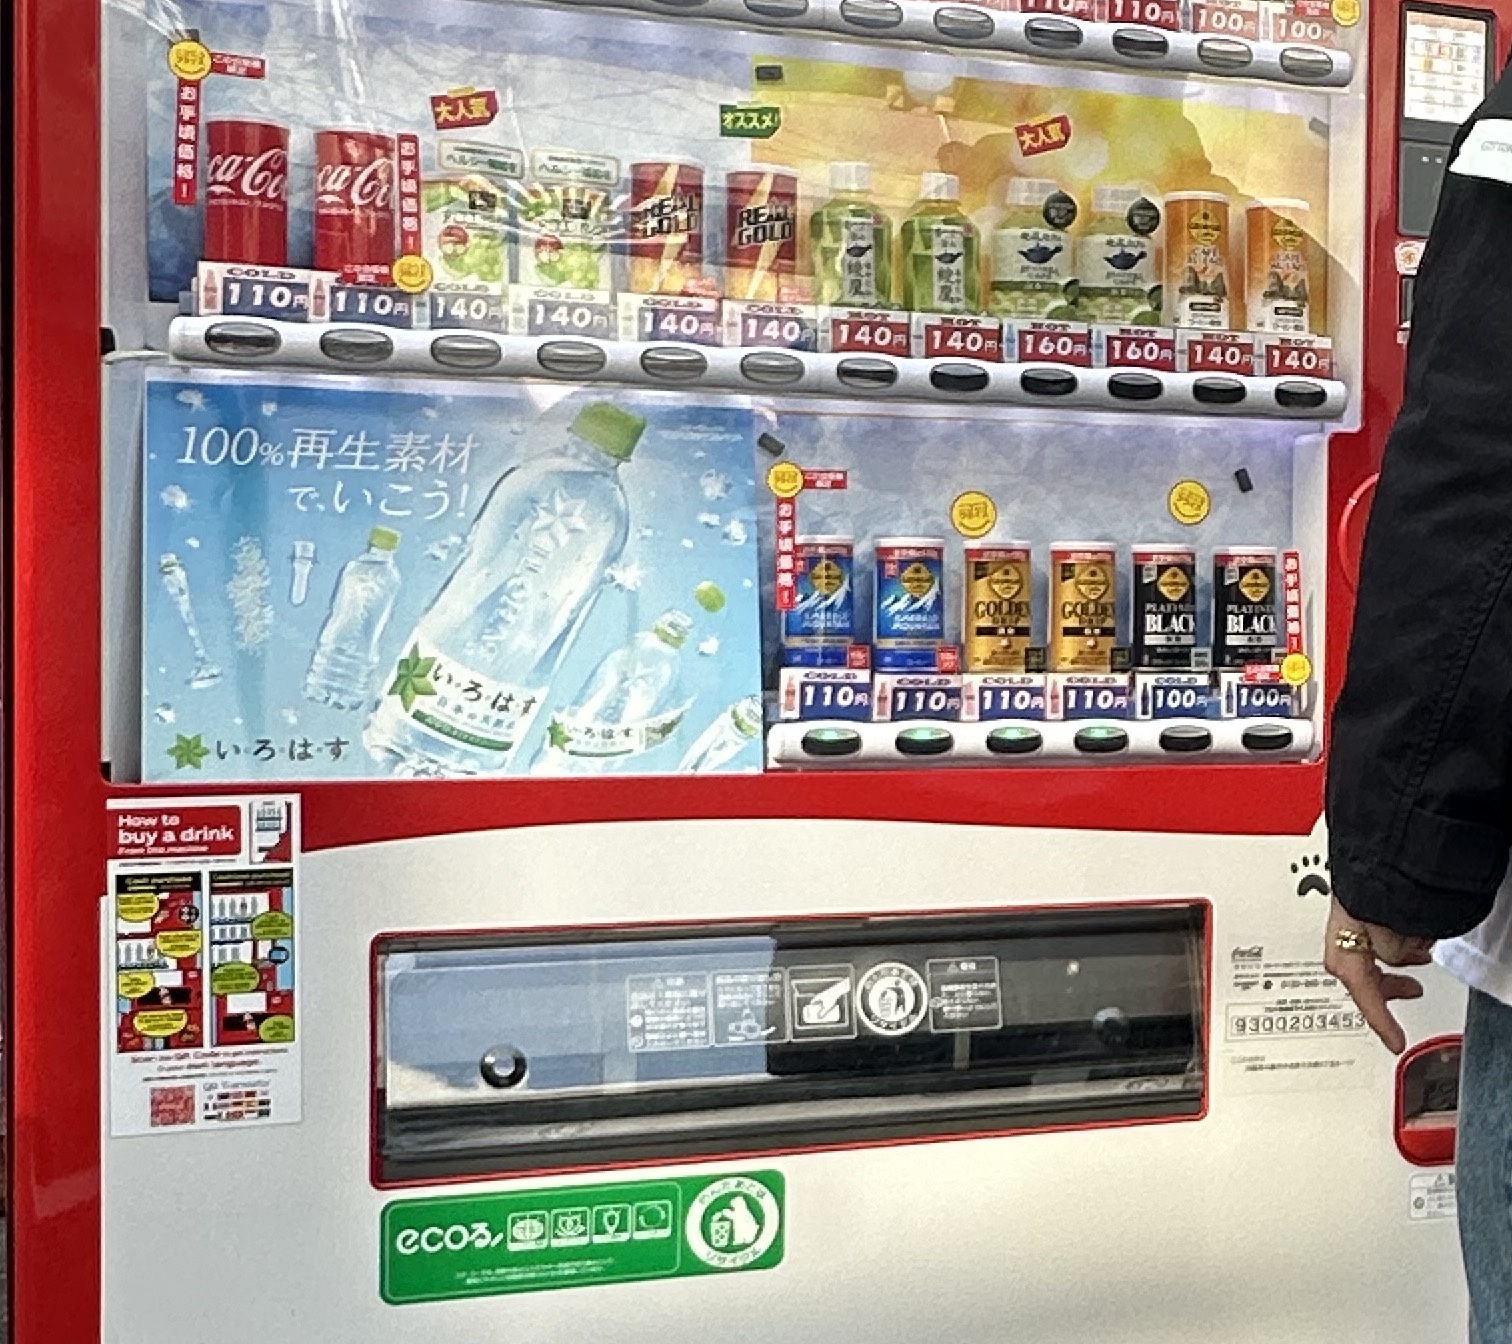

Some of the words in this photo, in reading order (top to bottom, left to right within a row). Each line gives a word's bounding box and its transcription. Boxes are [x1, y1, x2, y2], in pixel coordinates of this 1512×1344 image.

[737, 222, 793, 247] GOLD
[227, 266, 295, 281] COLD
[229, 283, 306, 309] 110円
[336, 291, 408, 316] 110円
[435, 298, 507, 319] 140円
[534, 304, 608, 328] 140円
[644, 311, 717, 335] 140円
[746, 316, 811, 340] 140円
[840, 325, 906, 346] 140円
[932, 330, 997, 353] 140円
[1023, 334, 1087, 356] 160円
[1112, 339, 1172, 361] 160円
[1194, 344, 1252, 366] 140円
[1271, 348, 1329, 370] 140円
[177, 424, 480, 475] 100%再生素材
[804, 685, 868, 706] 110円
[897, 691, 960, 710] 110円
[983, 690, 1044, 710] 110円
[1067, 689, 1127, 709] 110円
[1156, 688, 1207, 708] 100円
[1240, 688, 1291, 707] 100円
[118, 814, 158, 827] How
[162, 814, 180, 826] to
[118, 829, 158, 846] buy
[162, 830, 176, 842] a
[180, 825, 234, 842] drink
